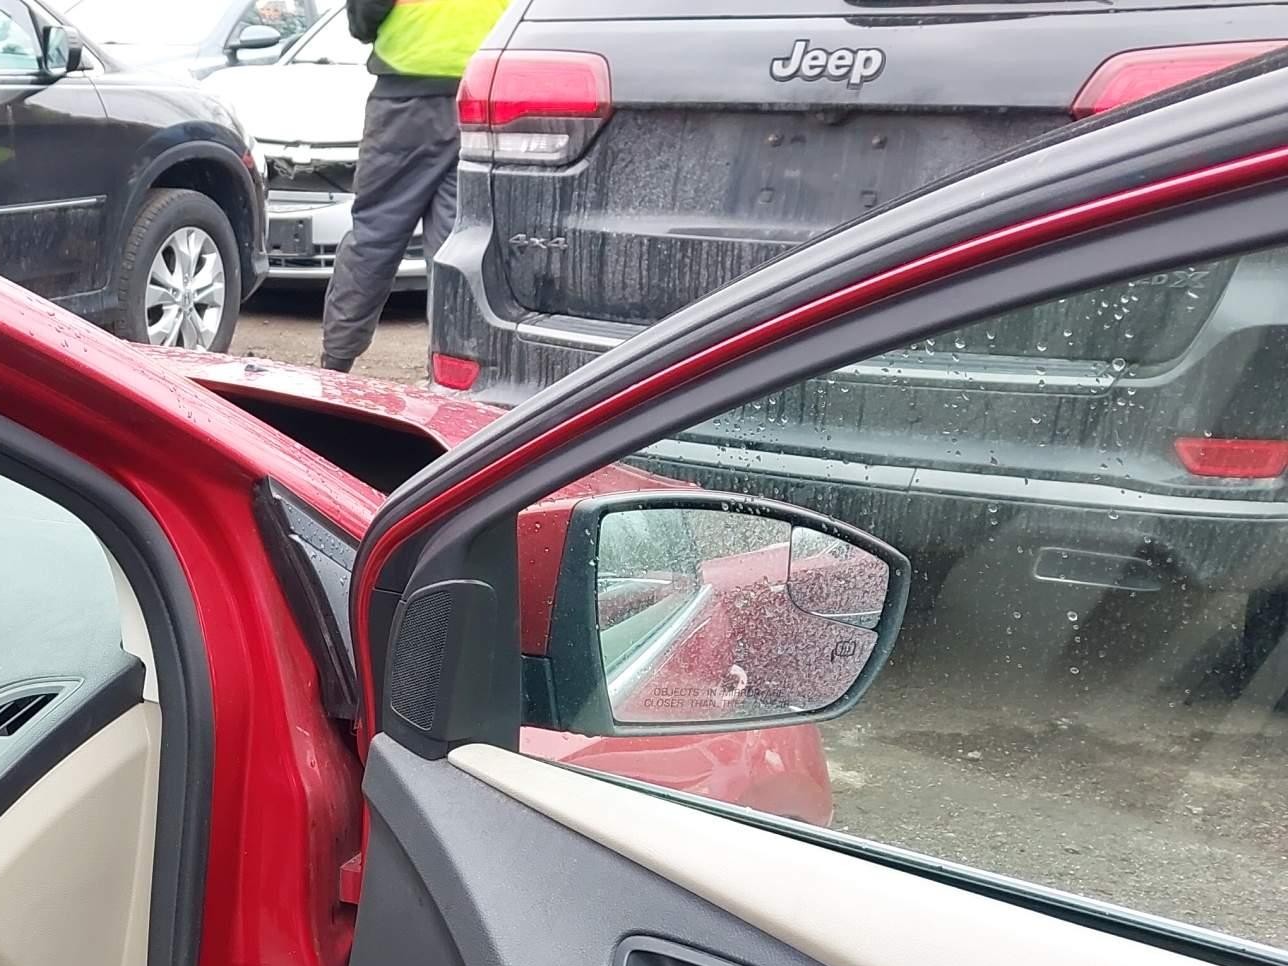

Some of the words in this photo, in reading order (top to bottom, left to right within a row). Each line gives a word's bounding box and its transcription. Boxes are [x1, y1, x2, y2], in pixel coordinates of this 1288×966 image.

[770, 39, 886, 90] Jeep
[509, 233, 568, 250] 4x4
[653, 687, 700, 697] OBJECTS
[707, 687, 718, 697] IN
[643, 698, 684, 708] CLOSER
[690, 698, 717, 708] THAN
